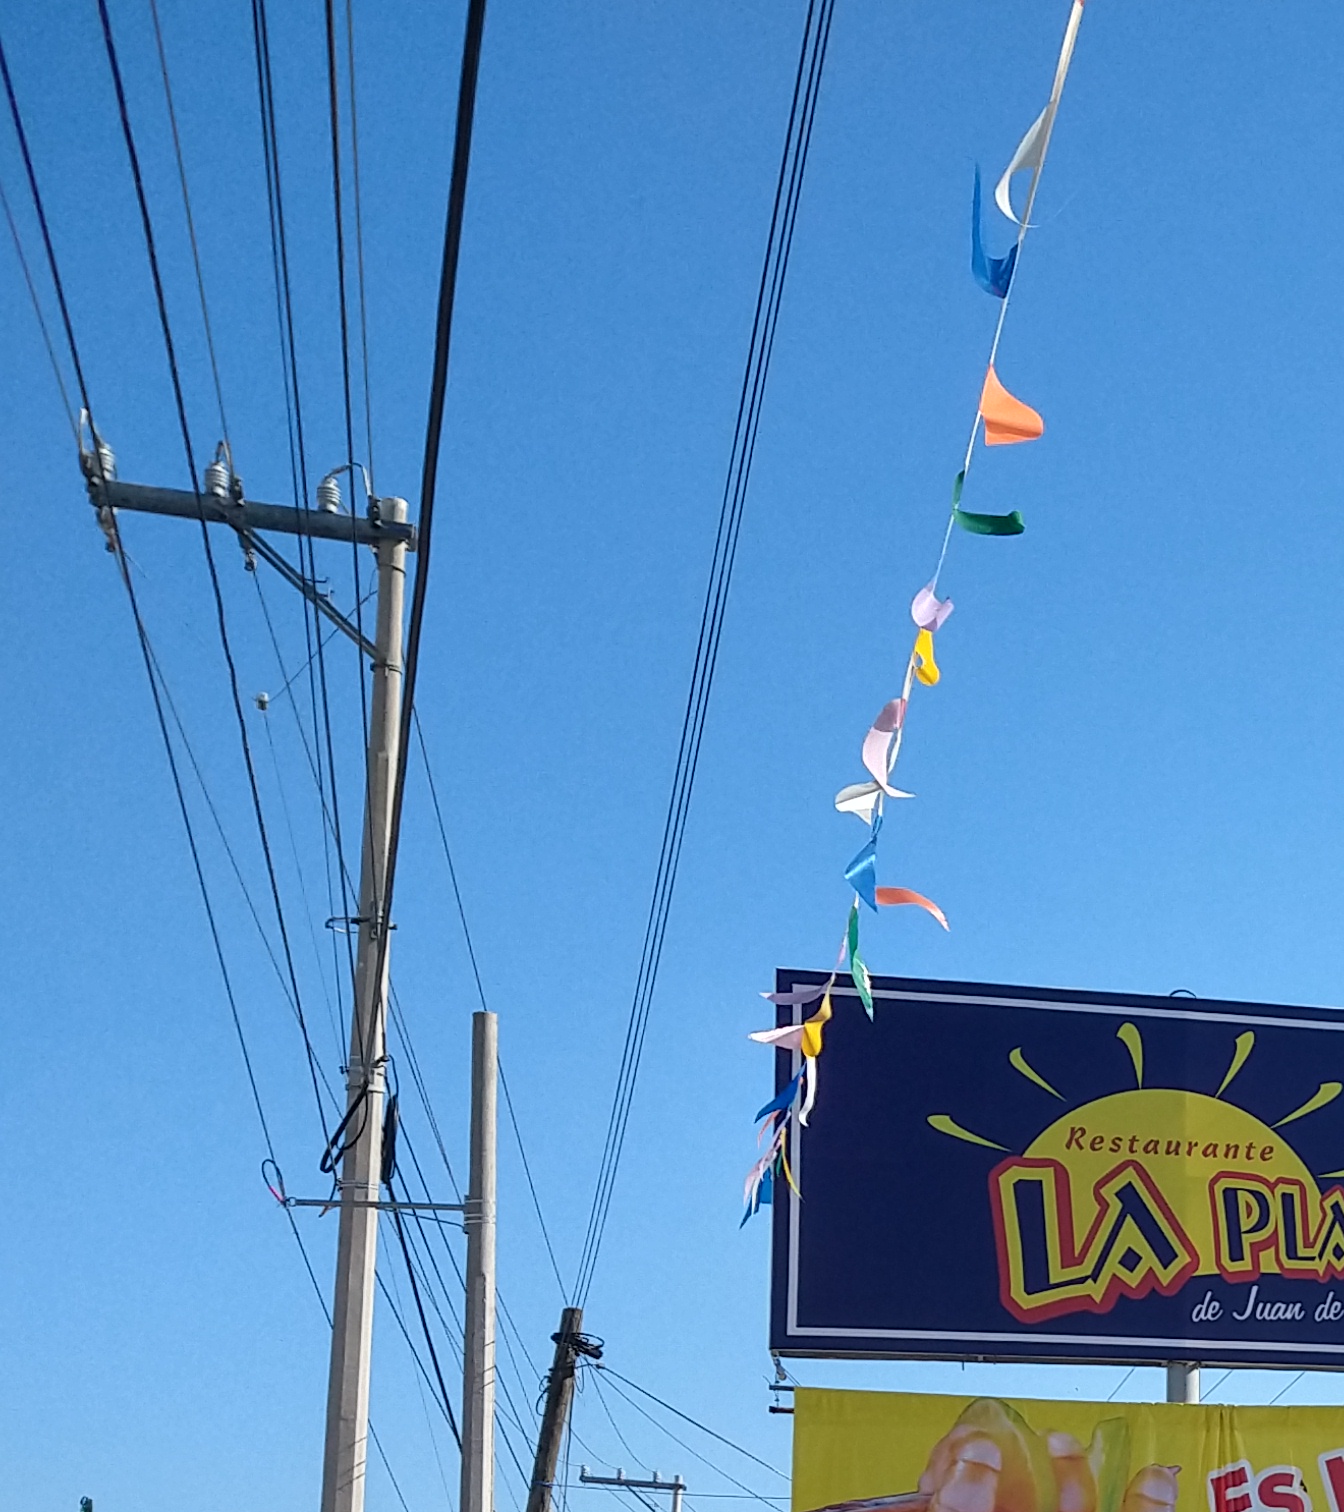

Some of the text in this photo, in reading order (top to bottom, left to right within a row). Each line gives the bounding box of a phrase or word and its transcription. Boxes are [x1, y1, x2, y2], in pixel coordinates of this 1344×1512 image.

[1065, 1126, 1275, 1162] Restaurante
[995, 1162, 1193, 1312] LA
[1192, 1290, 1223, 1322] de
[1232, 1285, 1305, 1321] Juan
[1314, 1291, 1344, 1322] de
